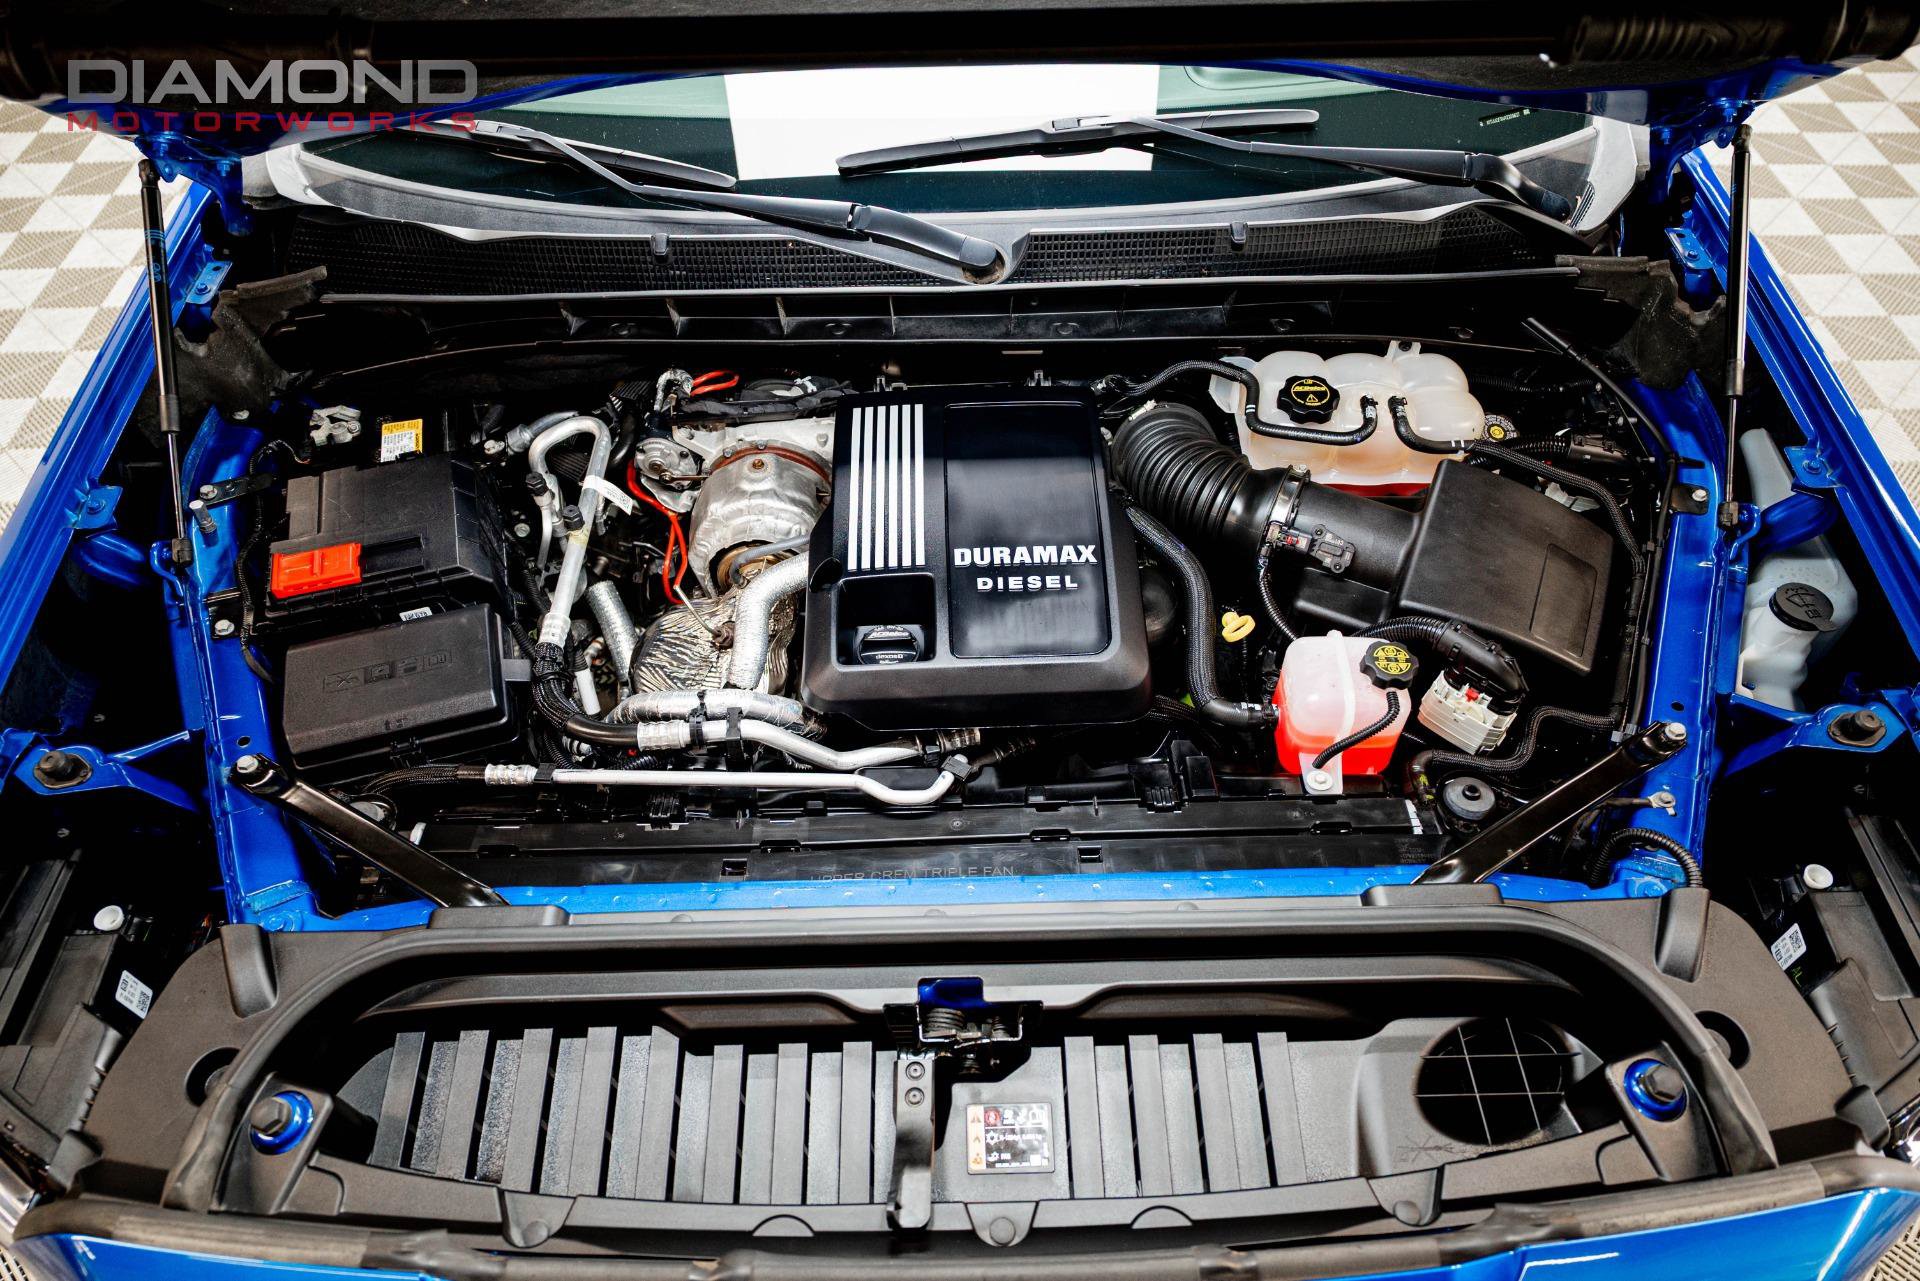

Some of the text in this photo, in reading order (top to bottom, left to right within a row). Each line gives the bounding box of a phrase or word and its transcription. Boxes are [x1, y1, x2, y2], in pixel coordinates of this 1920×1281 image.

[953, 545, 1098, 568] DURAMAX
[976, 575, 1079, 592] DIESEL
[919, 866, 978, 877] TRIPLE
[983, 866, 1015, 877] FAN
